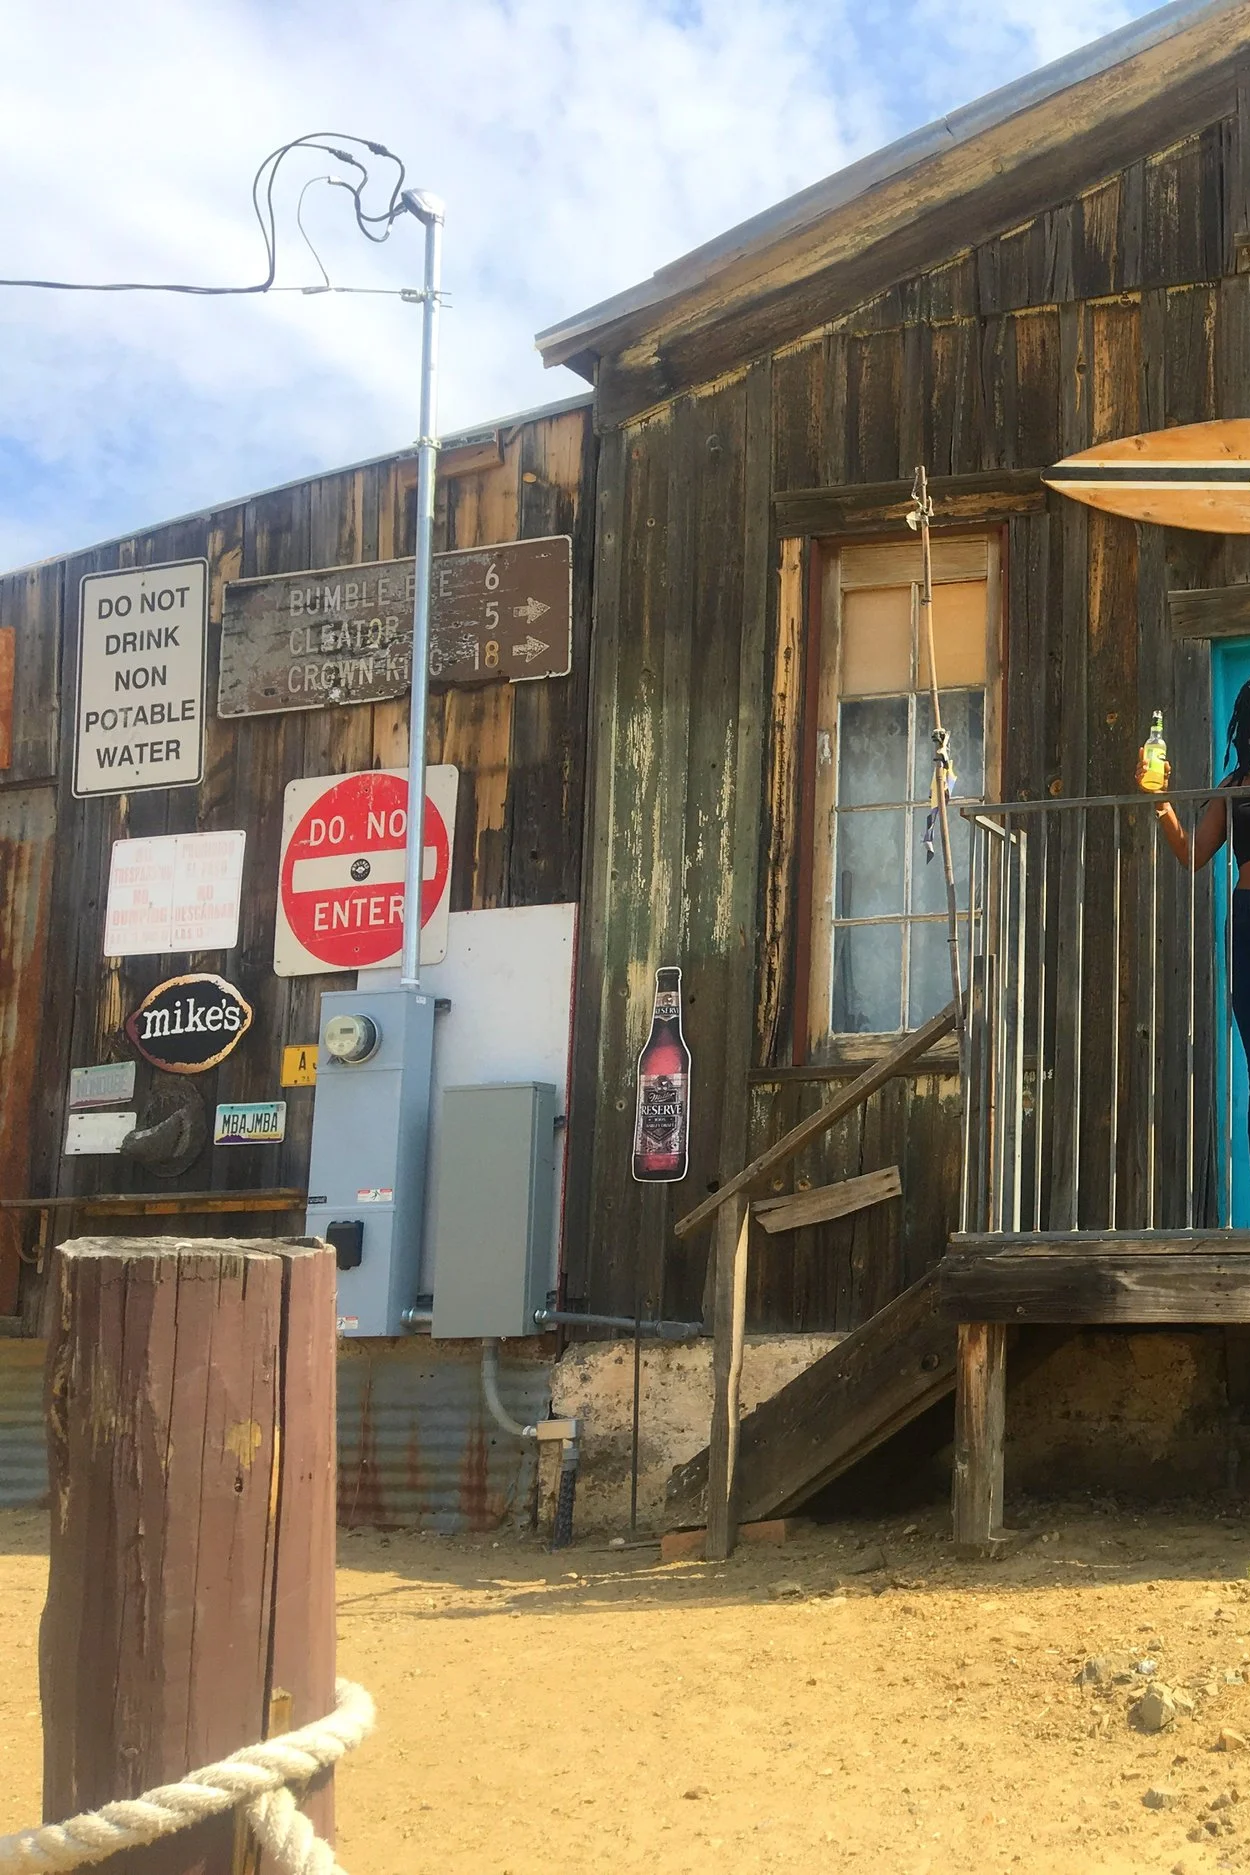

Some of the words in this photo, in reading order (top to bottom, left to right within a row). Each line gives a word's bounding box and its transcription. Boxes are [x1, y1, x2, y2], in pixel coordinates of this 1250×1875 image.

[98, 595, 132, 620] DO
[140, 586, 190, 614] NOT
[290, 578, 391, 617] BUMBLE
[405, 569, 453, 602] BE
[485, 563, 500, 591] 6
[105, 625, 180, 656] DRINK
[289, 616, 400, 656] CLEATOR
[485, 601, 500, 630] 5
[114, 665, 167, 692] NON
[288, 657, 375, 693] CROWN
[386, 648, 443, 682] KIG
[474, 640, 500, 671] 18
[85, 699, 196, 733] POTABLE
[96, 738, 181, 769] WATER
[309, 815, 346, 847] DO
[367, 808, 408, 840] NO
[314, 895, 405, 931] ENTER
[140, 998, 241, 1040] mike's
[221, 1112, 278, 1134] MBAJMBA
[641, 1104, 682, 1115] RESERVE
